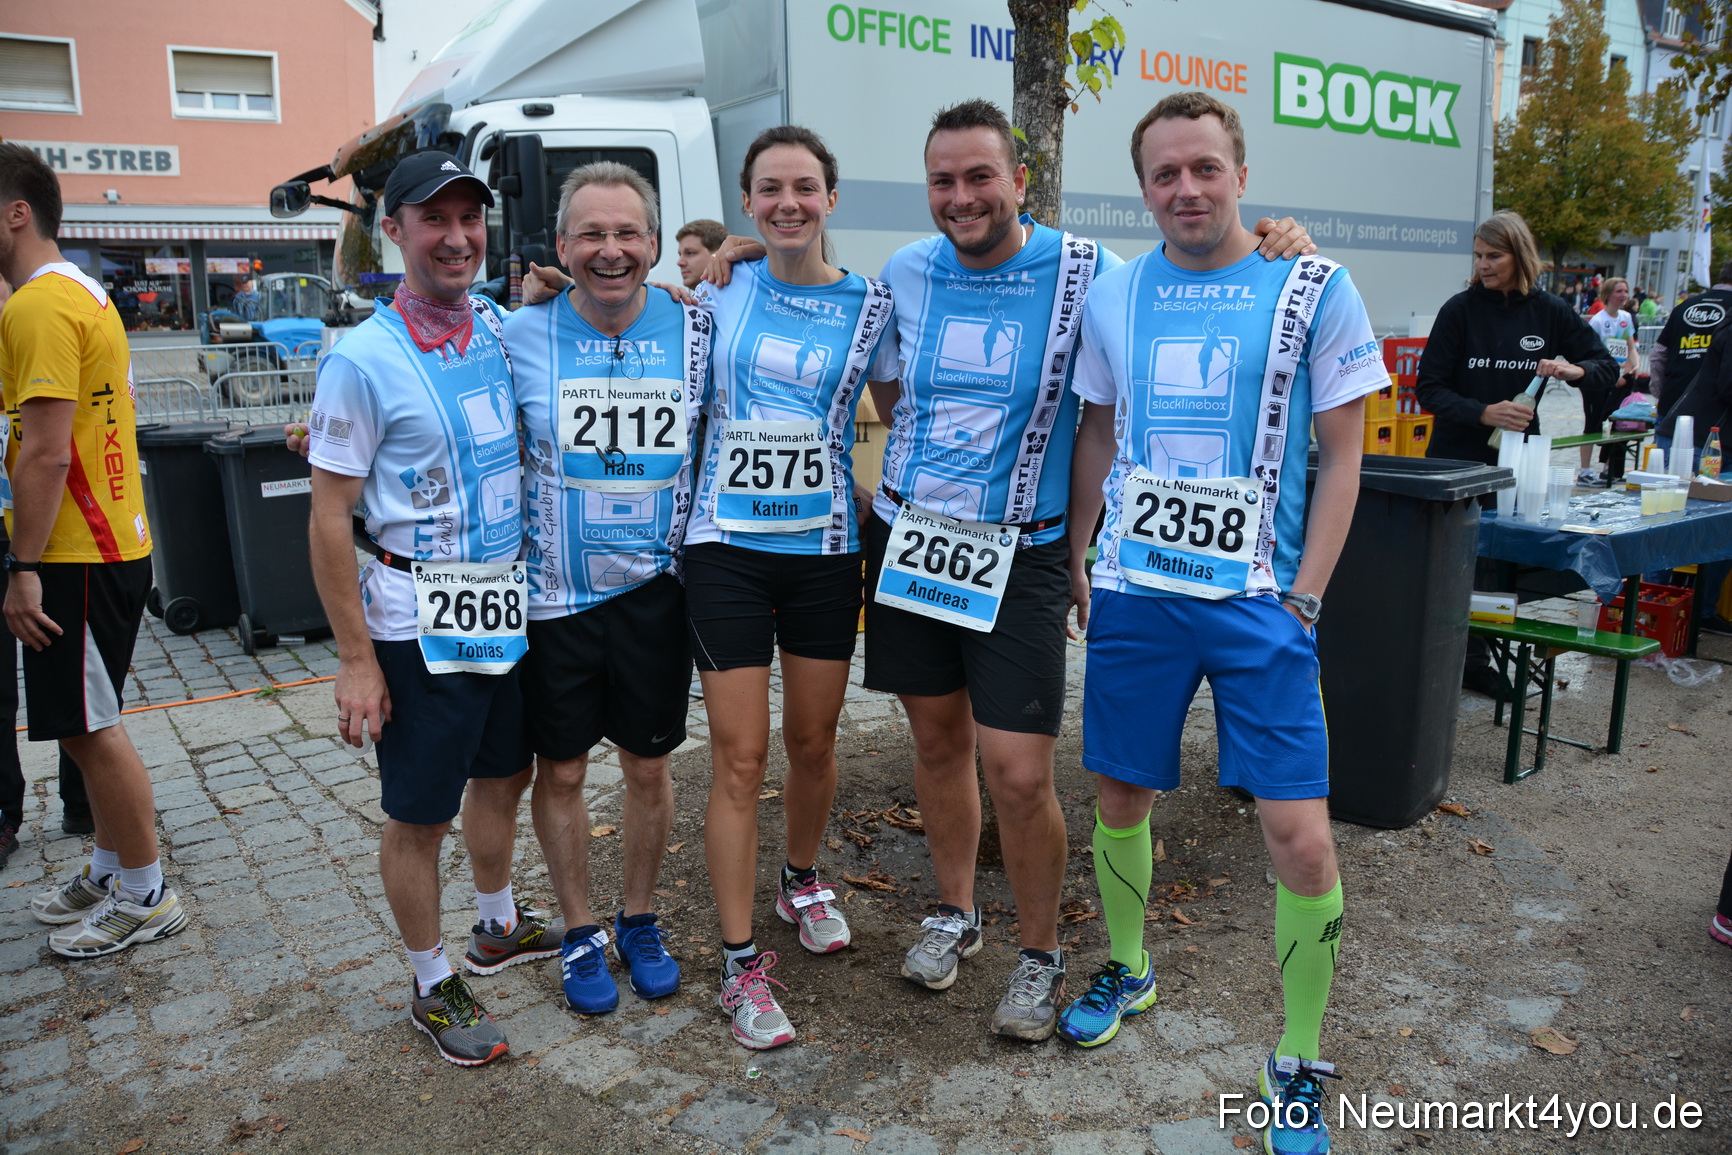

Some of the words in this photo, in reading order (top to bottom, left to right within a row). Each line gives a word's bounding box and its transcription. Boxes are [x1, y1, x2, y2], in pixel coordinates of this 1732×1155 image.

[827, 3, 951, 54] OFFICE
[971, 23, 1125, 76] INDRY
[1140, 48, 1248, 94] LOUNGE
[1279, 60, 1454, 140] BOCK
[34, 147, 172, 171] H-STREB
[1061, 200, 1158, 228] konline.d
[1336, 218, 1354, 243] by
[1357, 222, 1398, 241] smart
[1400, 227, 1458, 248] concepts
[769, 288, 847, 319] VIERTL
[945, 280, 993, 296] DESIGN
[994, 283, 1036, 298] GmbH
[1056, 263, 1081, 337] VIERTL
[1069, 298, 1085, 338] DESIGN
[1078, 263, 1093, 296] GmbH
[1156, 284, 1256, 299] VIERTL
[765, 302, 810, 322] DESIGN
[811, 314, 847, 330] GmbH
[1153, 300, 1210, 313] DESIGN
[1211, 300, 1256, 313] GmbH
[1278, 285, 1307, 354] VIERTL
[855, 301, 882, 355] VIERTL
[863, 326, 882, 358] DESIGN
[877, 301, 892, 327] GmbH
[1291, 315, 1309, 359] DESIGN
[1301, 286, 1320, 319] GmbH
[575, 339, 665, 354] VIERTL
[1337, 340, 1379, 366] VIER
[1680, 334, 1712, 349] NEU
[438, 354, 475, 372] DESIGN
[476, 348, 499, 366] GmbH
[575, 355, 626, 367] DESIGN
[629, 354, 667, 367] GmbH
[690, 336, 700, 403] VIERTL
[1339, 355, 1377, 378] DESIGN
[1468, 357, 1491, 369] get
[1495, 358, 1538, 370] movin
[562, 388, 605, 399] PARTL
[607, 388, 667, 400] Neumarkt
[753, 376, 814, 401] slacklinebox
[936, 371, 1009, 389] slacklinebox
[1151, 398, 1227, 412] slacklinebox
[573, 405, 676, 448] 2112
[725, 431, 756, 442] PARTL
[758, 431, 815, 443] Neumarkt
[564, 443, 570, 451] D
[604, 459, 645, 476] Hans
[694, 425, 721, 520] VIERTL
[728, 447, 824, 489] 2575
[1029, 457, 1041, 487] GmbH
[263, 479, 307, 491] NEUMARKT
[1008, 457, 1031, 523] VIERTL
[1173, 479, 1240, 500] Neumarkt
[540, 481, 558, 536] GmbH
[752, 499, 799, 517] Katrin
[1132, 491, 1247, 553] 2358
[436, 510, 456, 556] GmbH
[486, 517, 521, 540] raumbo
[525, 481, 542, 596] VIERTL
[585, 525, 654, 539] raumbox
[900, 510, 937, 528] PARTL
[938, 521, 995, 543] Neumarkt
[1123, 530, 1129, 538] A
[543, 540, 560, 603] DESIGN
[896, 529, 1000, 589] 2662
[1145, 550, 1215, 581] Mathias
[416, 573, 459, 584] PARTL
[461, 573, 510, 584] Neumarkt
[906, 579, 970, 610] Andreas
[428, 588, 522, 632] 2668
[456, 641, 504, 659] Tobias
